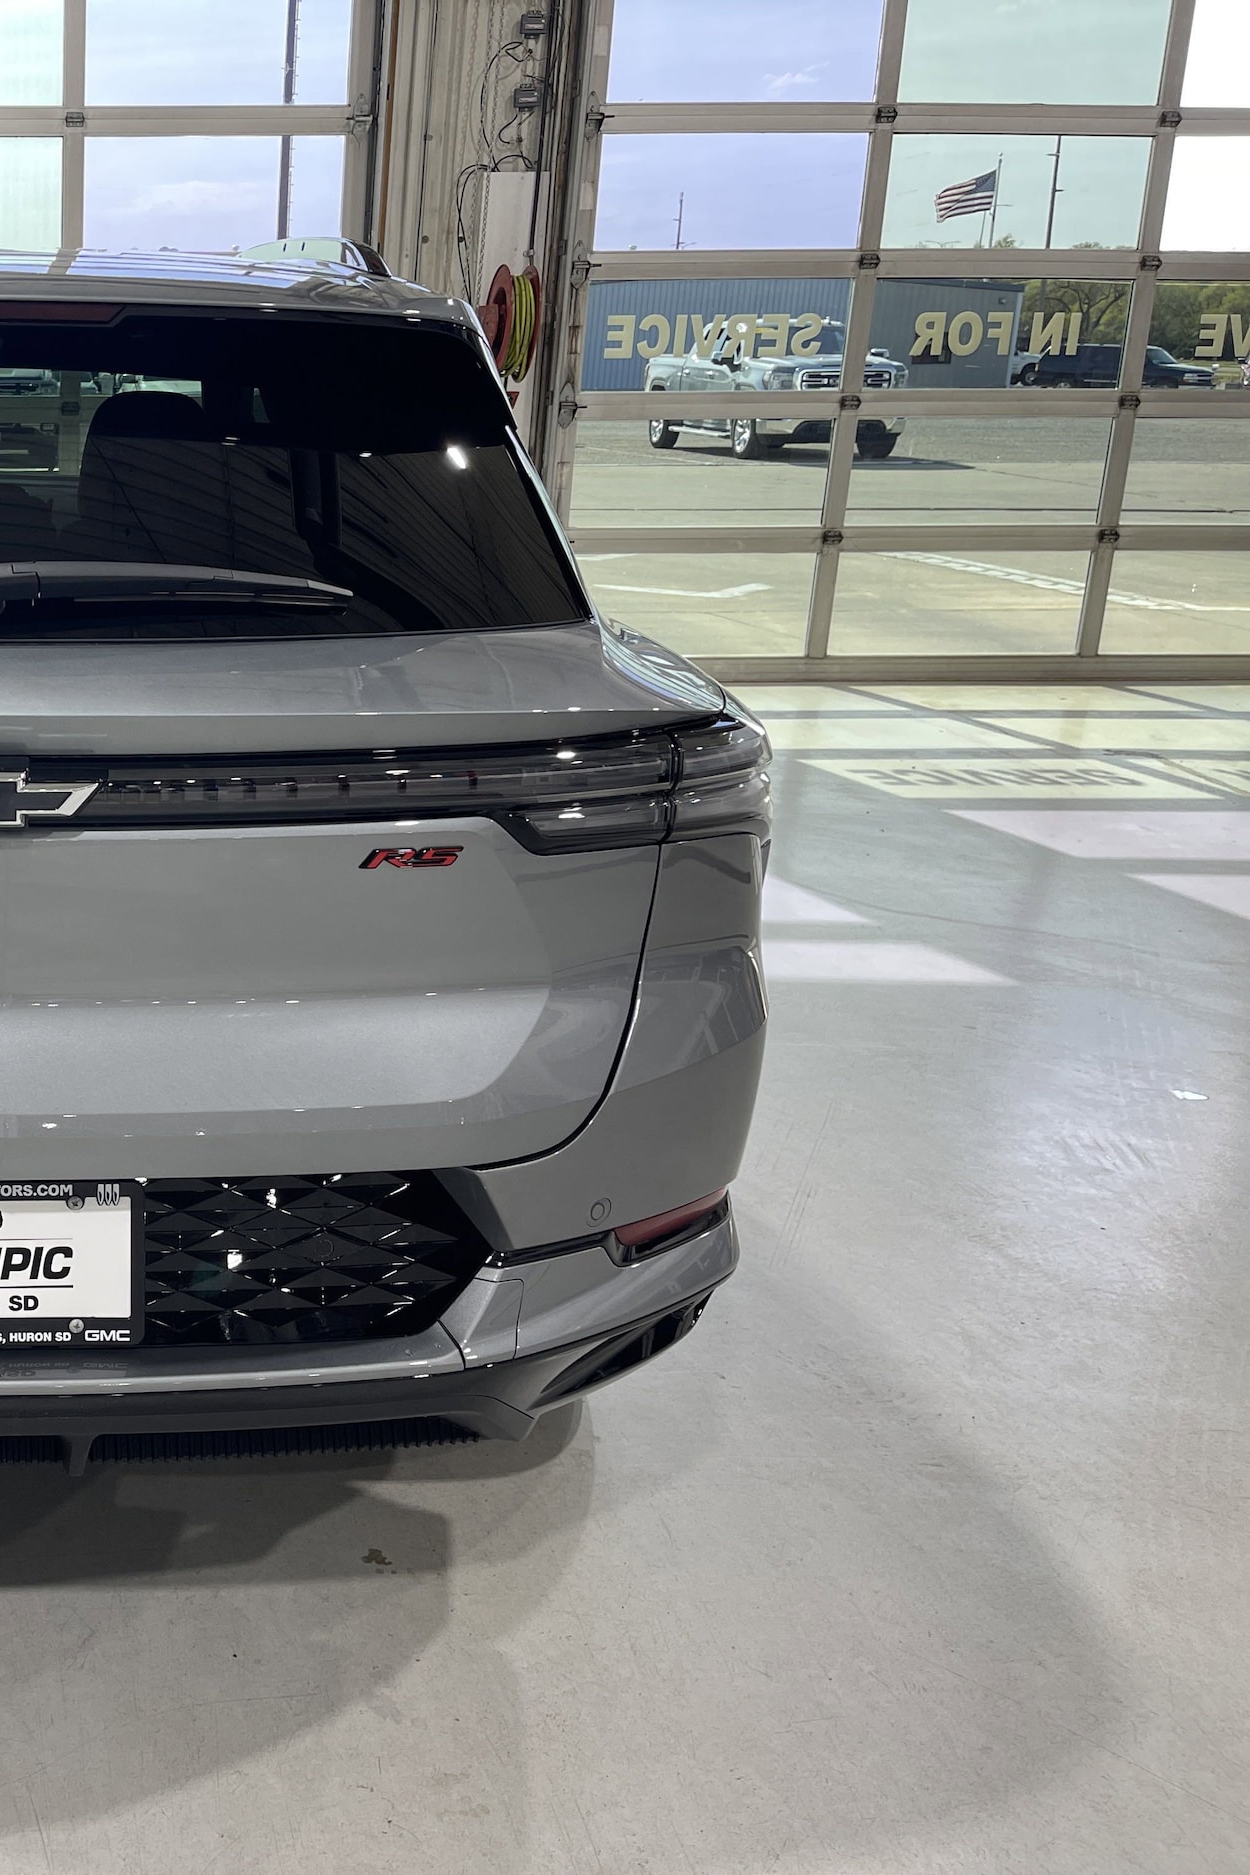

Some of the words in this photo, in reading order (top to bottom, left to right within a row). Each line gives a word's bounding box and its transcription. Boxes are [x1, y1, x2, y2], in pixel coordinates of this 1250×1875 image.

[358, 845, 464, 869] RS
[8, 1294, 39, 1311] SD
[9, 1332, 52, 1343] HURON
[54, 1331, 72, 1342] SD
[84, 1329, 131, 1342] GMC
